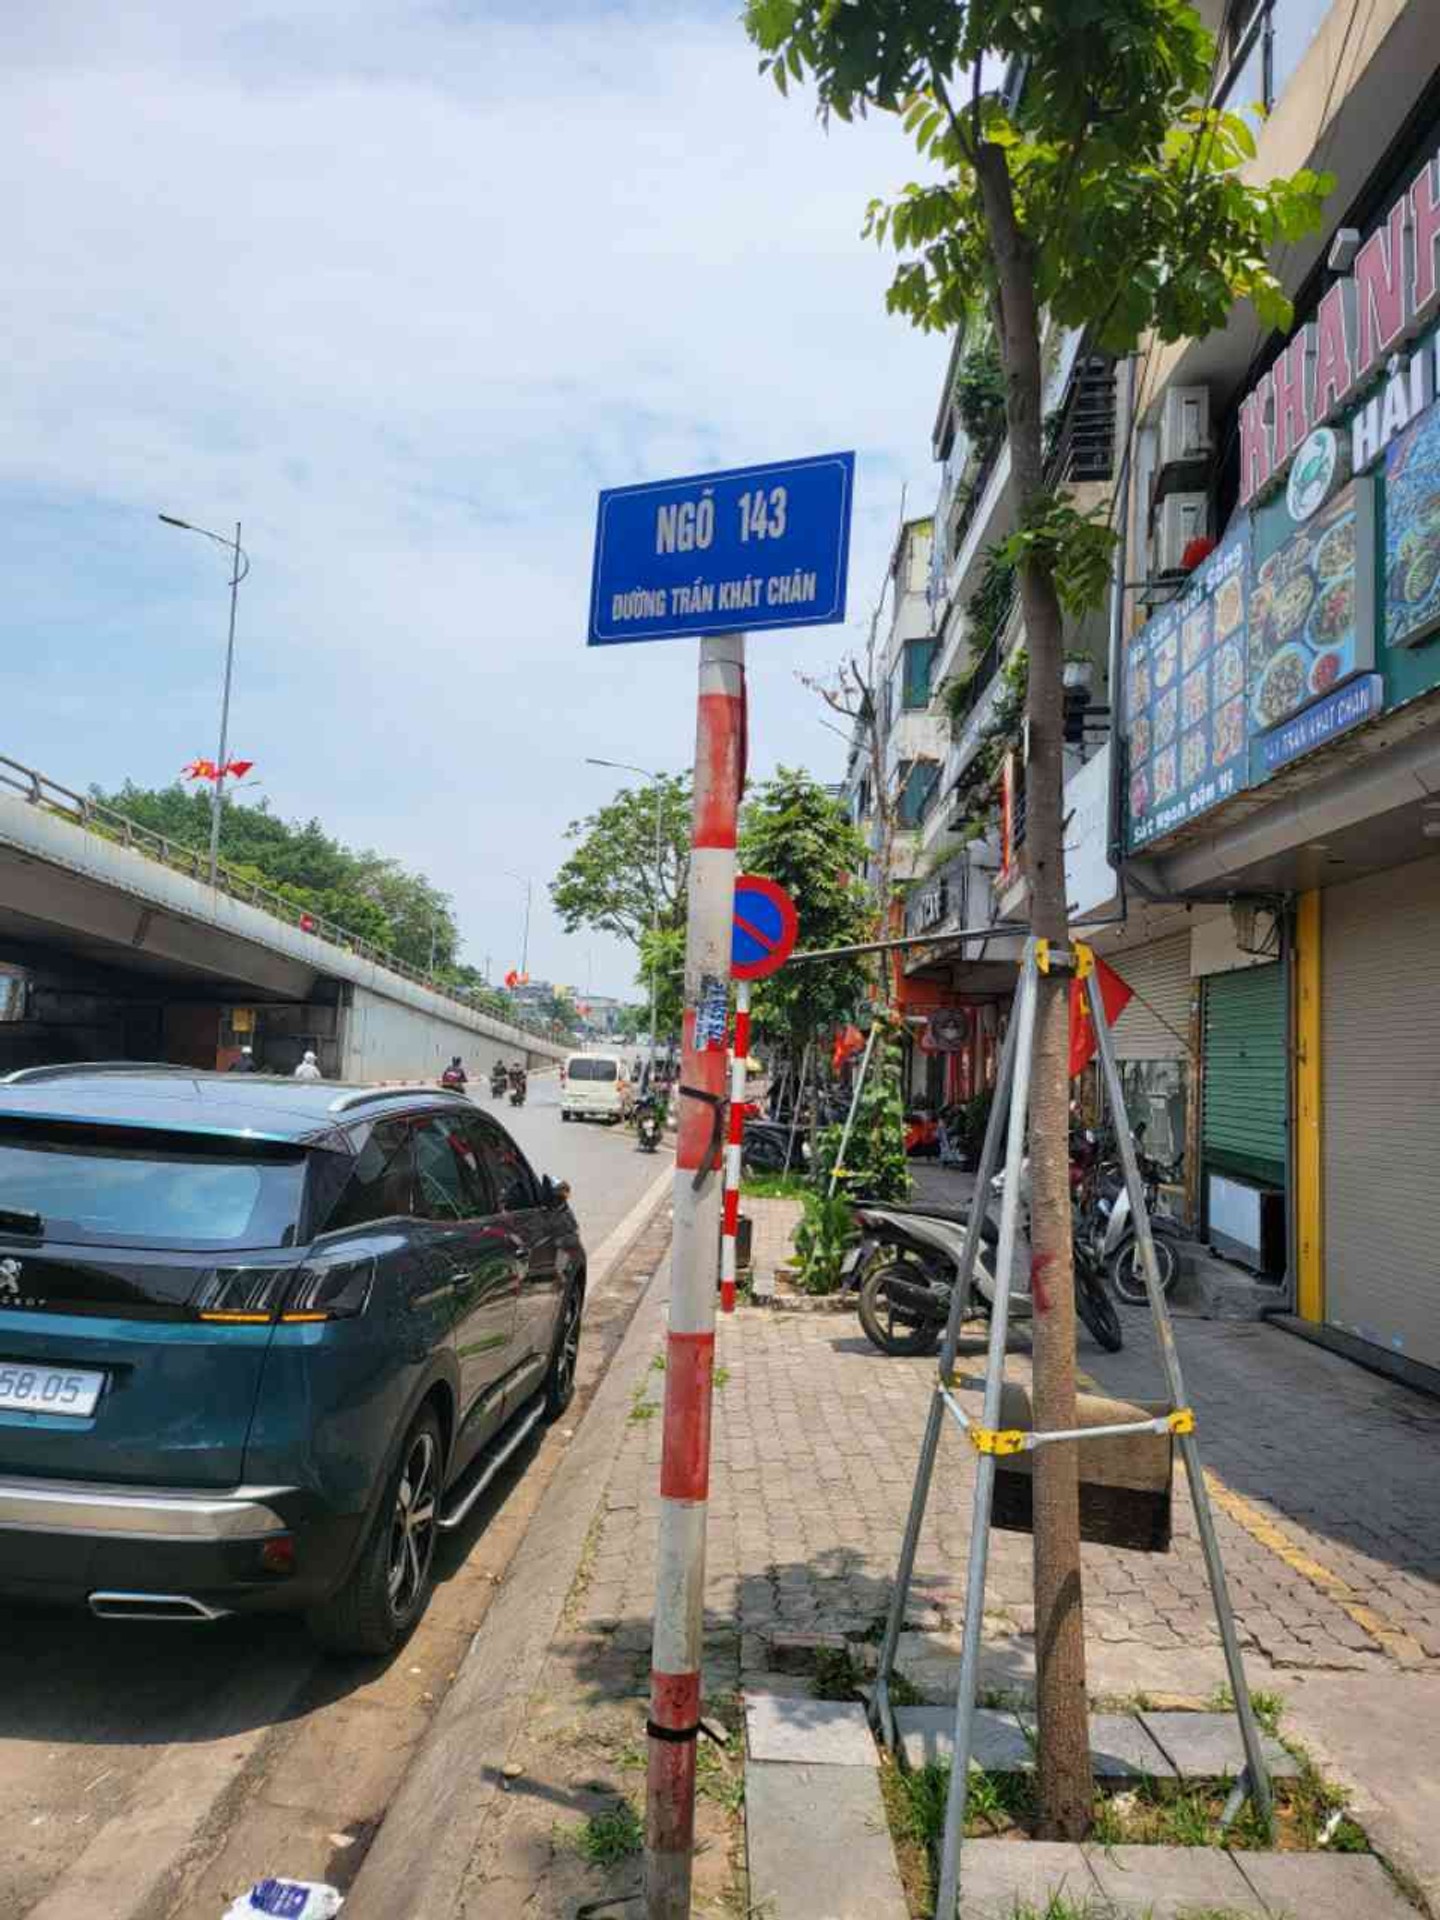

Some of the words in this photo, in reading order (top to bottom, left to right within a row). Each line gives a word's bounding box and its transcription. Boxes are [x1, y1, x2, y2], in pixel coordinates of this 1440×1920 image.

[656, 488, 715, 554] NGÕ
[738, 487, 787, 542] 143
[718, 575, 763, 611] KHÁT
[767, 568, 816, 606] CHÂN
